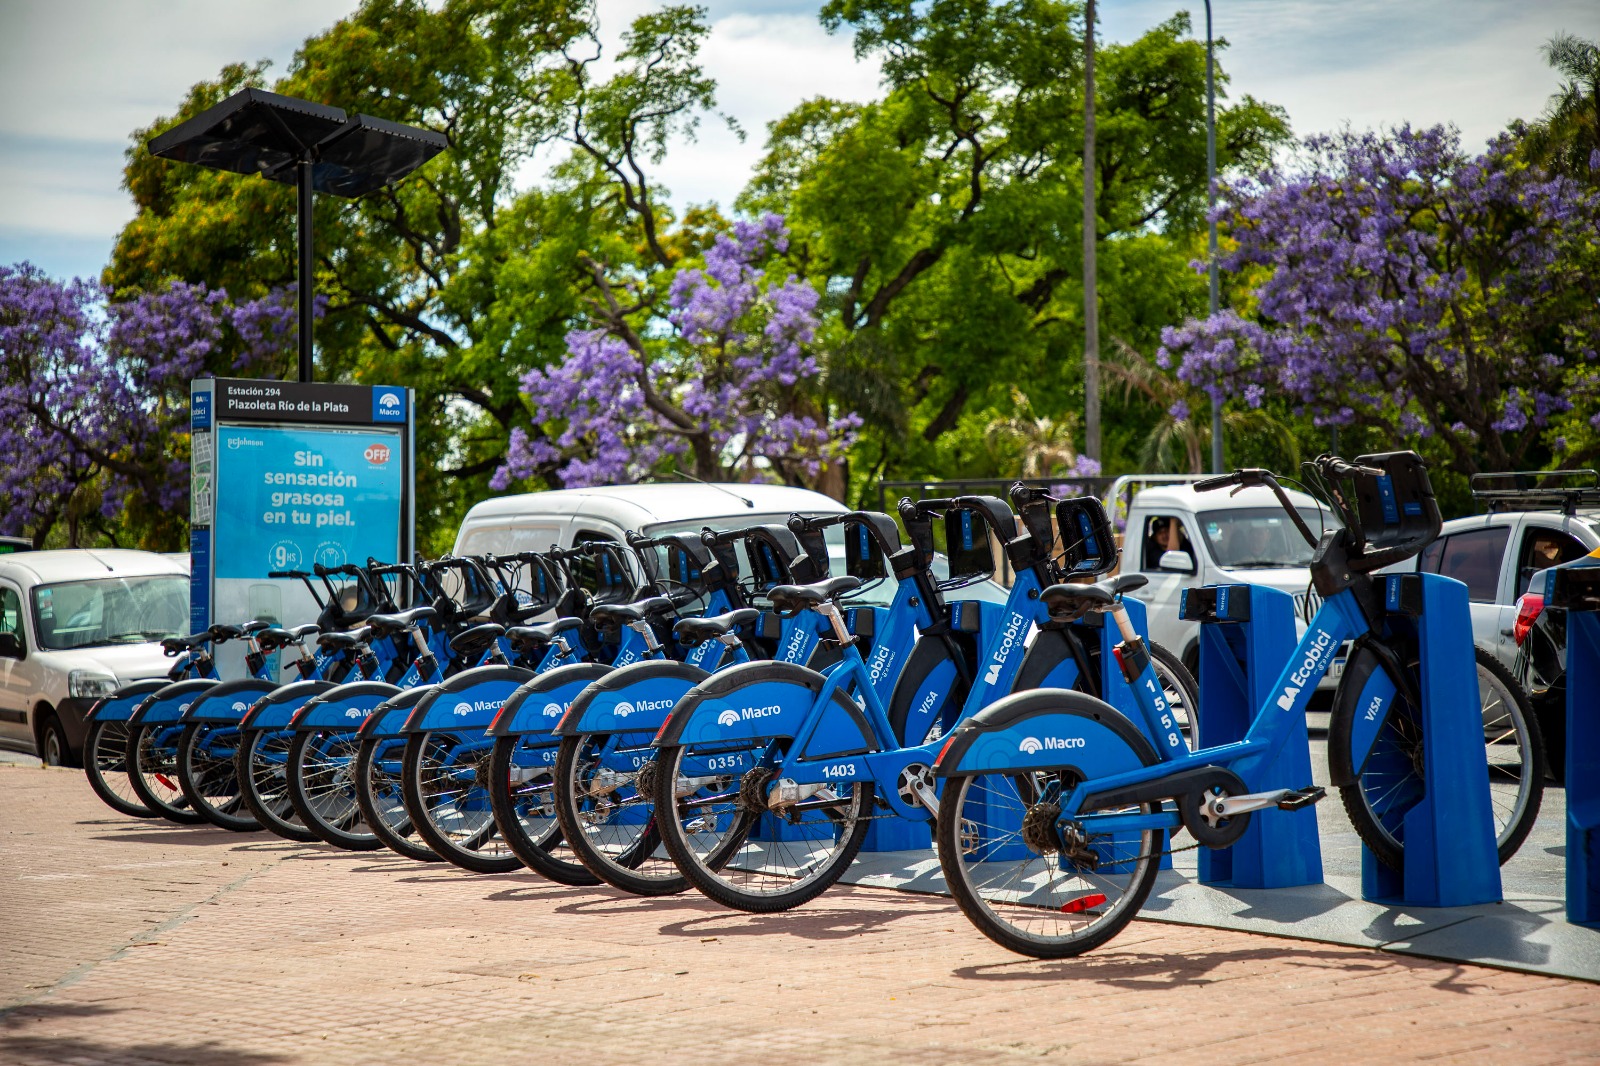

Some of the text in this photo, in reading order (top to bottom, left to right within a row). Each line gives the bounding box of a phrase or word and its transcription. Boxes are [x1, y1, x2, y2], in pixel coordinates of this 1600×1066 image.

[227, 387, 281, 396] Estación 294
[228, 399, 349, 413] Plazoleta Río de la Plata
[294, 451, 323, 467] Sin
[364, 448, 391, 461] OFF!
[264, 470, 357, 488] sensación
[271, 492, 344, 507] grasosa
[263, 510, 355, 528] en tu piel.
[784, 627, 804, 663] cobici
[993, 611, 1023, 663] Ecobici
[869, 645, 890, 686] cobici
[1276, 629, 1331, 712] BA Ecobici
[636, 699, 674, 712] Macro
[918, 690, 938, 715] VISA
[1364, 696, 1383, 721] VISA
[741, 704, 781, 720] Macro
[1146, 679, 1179, 747] 1558
[1044, 736, 1086, 750] Macro
[708, 754, 743, 770] 0351
[822, 763, 856, 778] 1403
